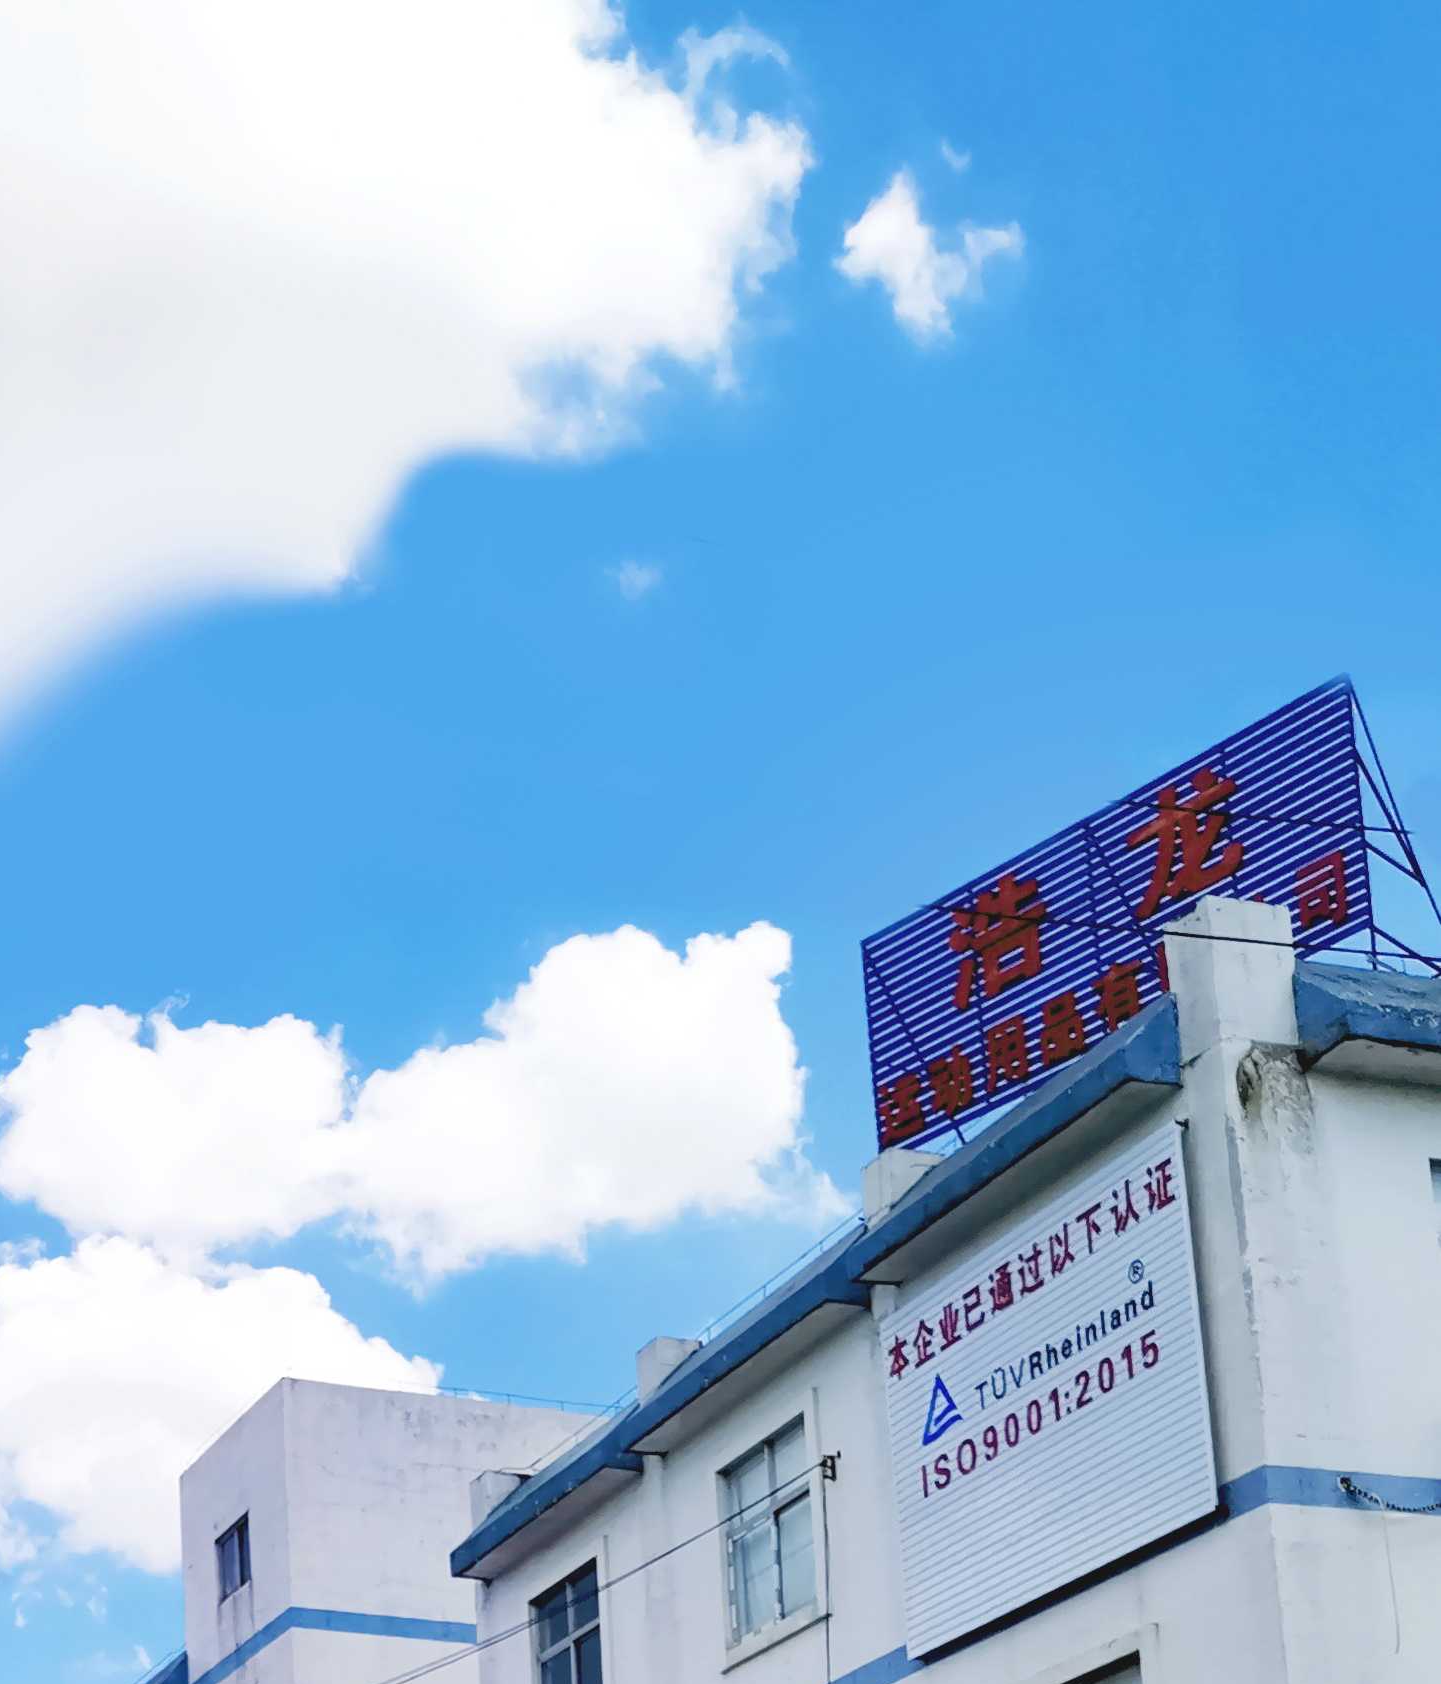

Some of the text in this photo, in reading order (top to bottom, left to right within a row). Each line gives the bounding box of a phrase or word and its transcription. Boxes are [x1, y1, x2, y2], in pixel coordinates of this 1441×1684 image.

[889, 1158, 1176, 1380] 本企业已通过以下认证
[921, 1329, 1160, 1499] ISO9001:2015
